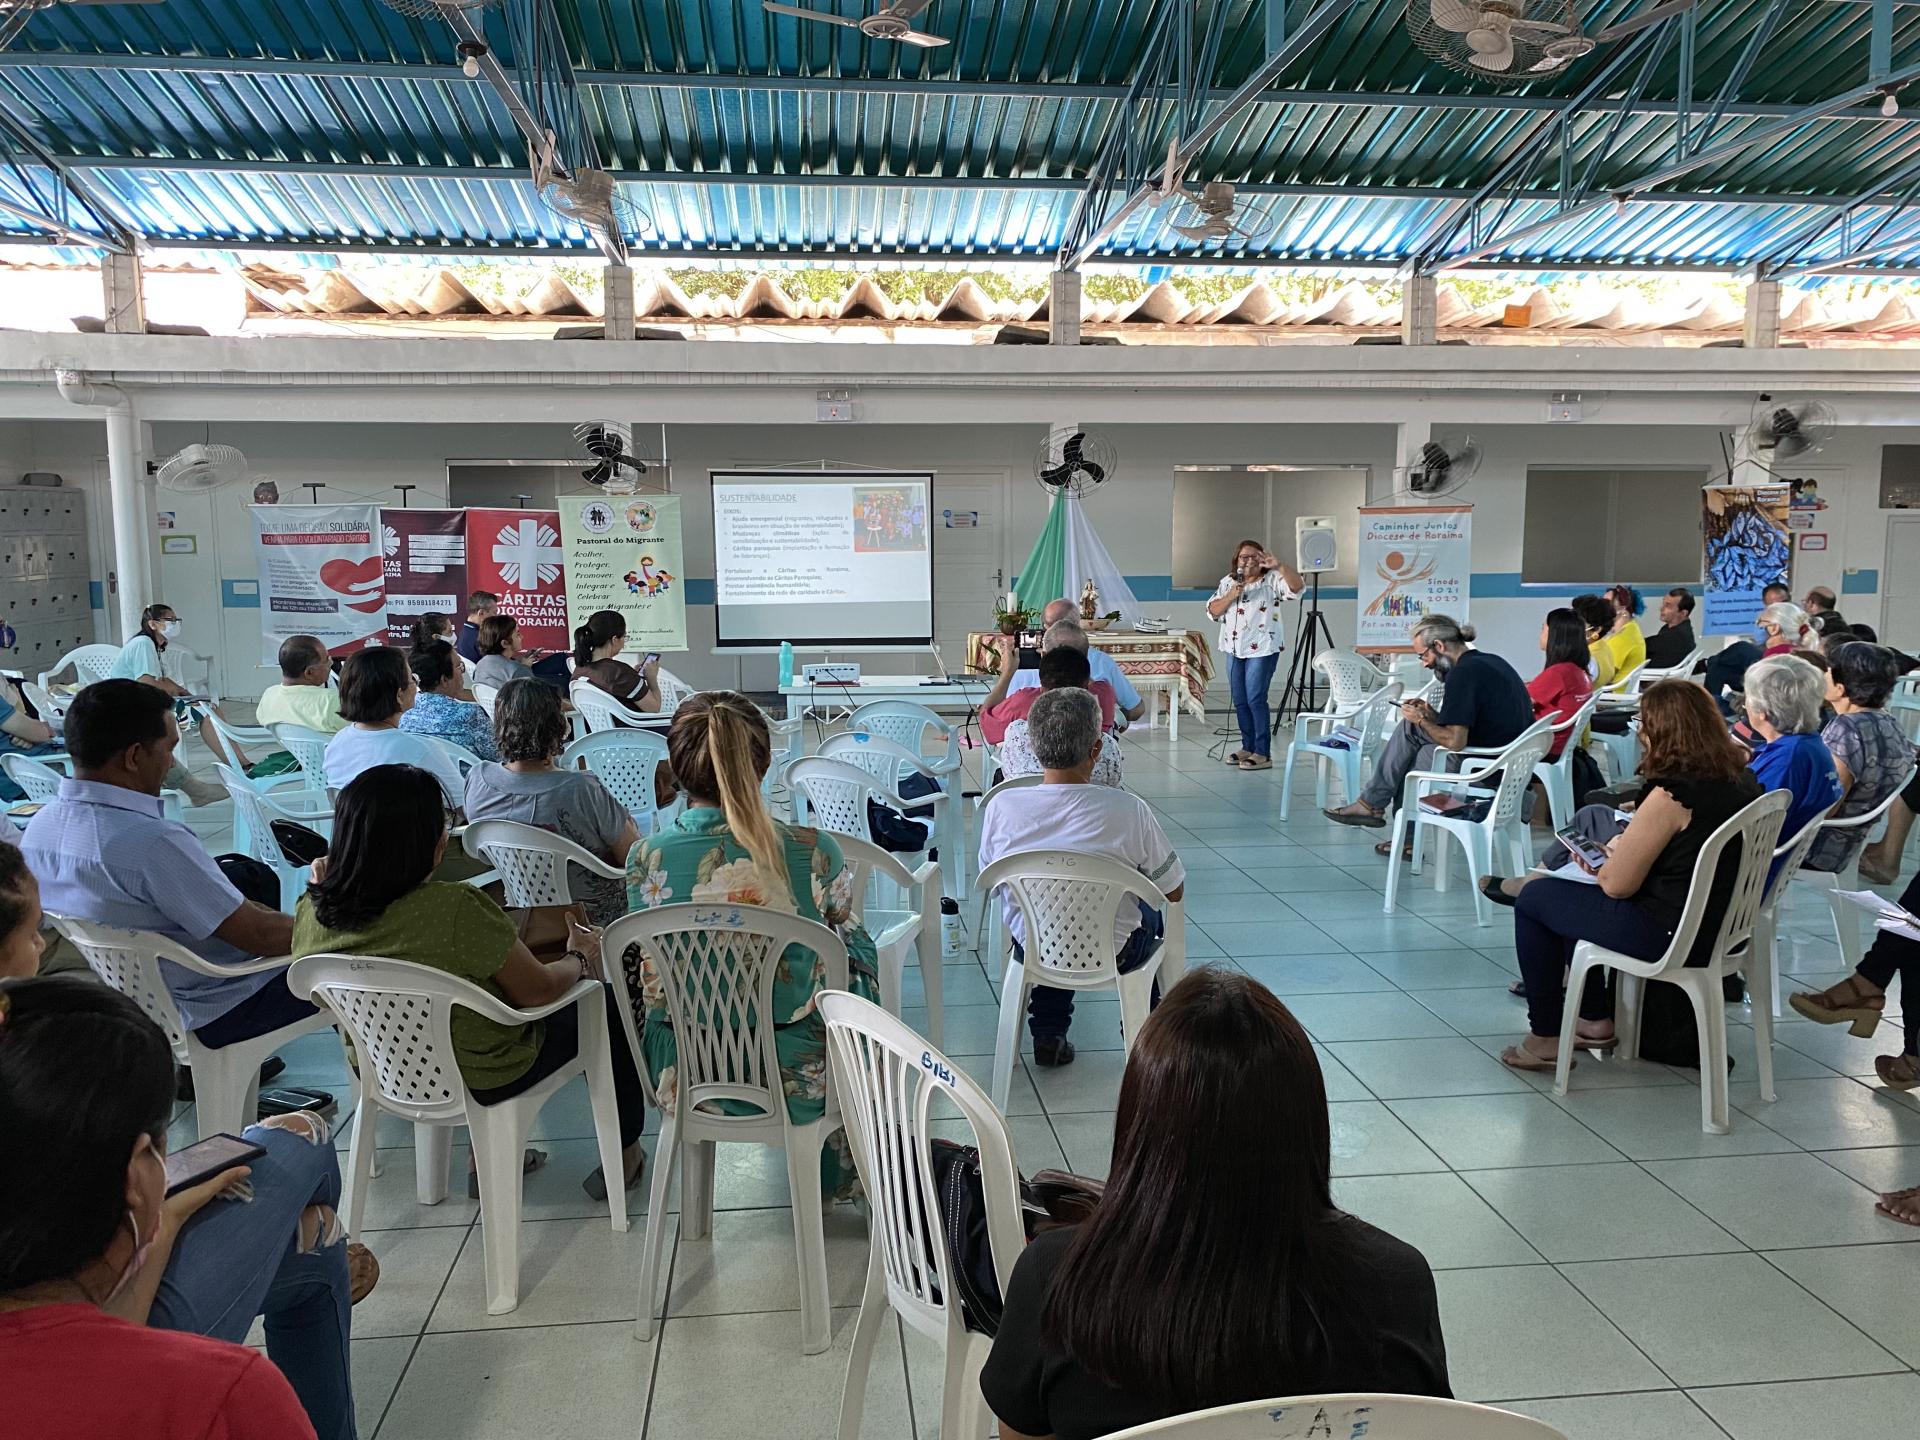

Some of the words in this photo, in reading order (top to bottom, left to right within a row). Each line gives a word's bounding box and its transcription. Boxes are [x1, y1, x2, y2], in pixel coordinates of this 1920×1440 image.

[720, 494, 798, 502] SUSTENTABILIDADE
[260, 522, 279, 532] TOME
[281, 522, 298, 532] UMA
[299, 520, 329, 532] DECISÃO
[329, 520, 371, 531] SOLIDÁRIA
[1373, 522, 1420, 530] Caminhar
[1424, 522, 1458, 530] Juntos
[284, 535, 298, 543] PARA
[304, 534, 344, 543] VOLUNTARIADO
[345, 534, 368, 543] CÁRITAS
[1367, 532, 1405, 540] Diocese
[1409, 532, 1420, 540] de
[1425, 531, 1463, 539] Roraima
[576, 583, 608, 591] Integrar
[495, 590, 566, 607] CÁRITAS
[607, 603, 645, 612] Migrantes
[515, 617, 566, 627] ORAIMA
